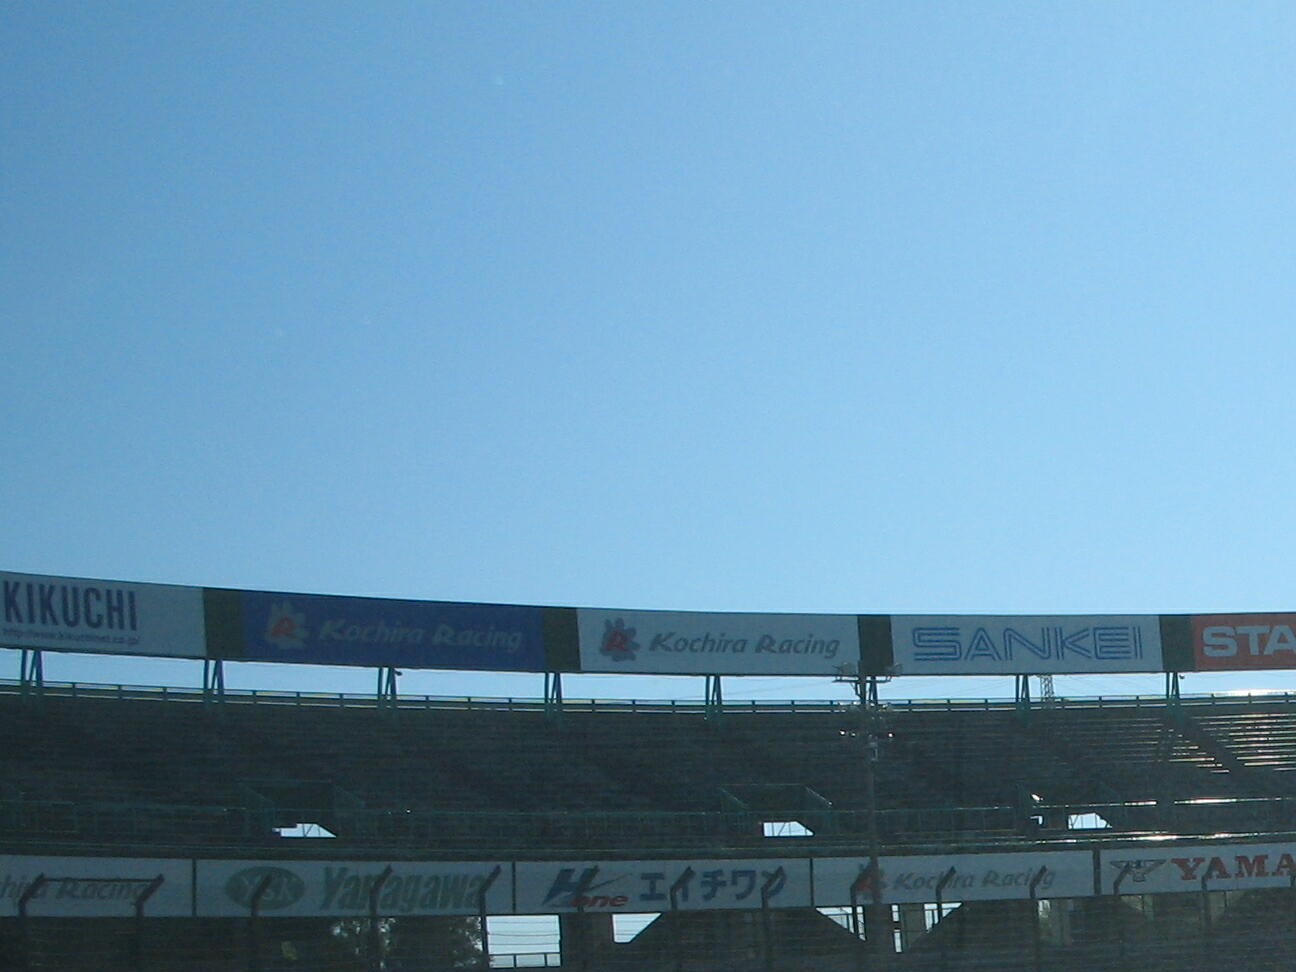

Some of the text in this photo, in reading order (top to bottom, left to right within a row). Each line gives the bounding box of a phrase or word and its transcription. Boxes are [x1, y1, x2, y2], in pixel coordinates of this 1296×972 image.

[4, 581, 137, 631] KIKUCHI
[319, 618, 523, 654] Kochira Racing
[648, 632, 841, 660] Kochira Racing
[912, 627, 1144, 661] SANKEI
[981, 868, 1056, 890] Racig
